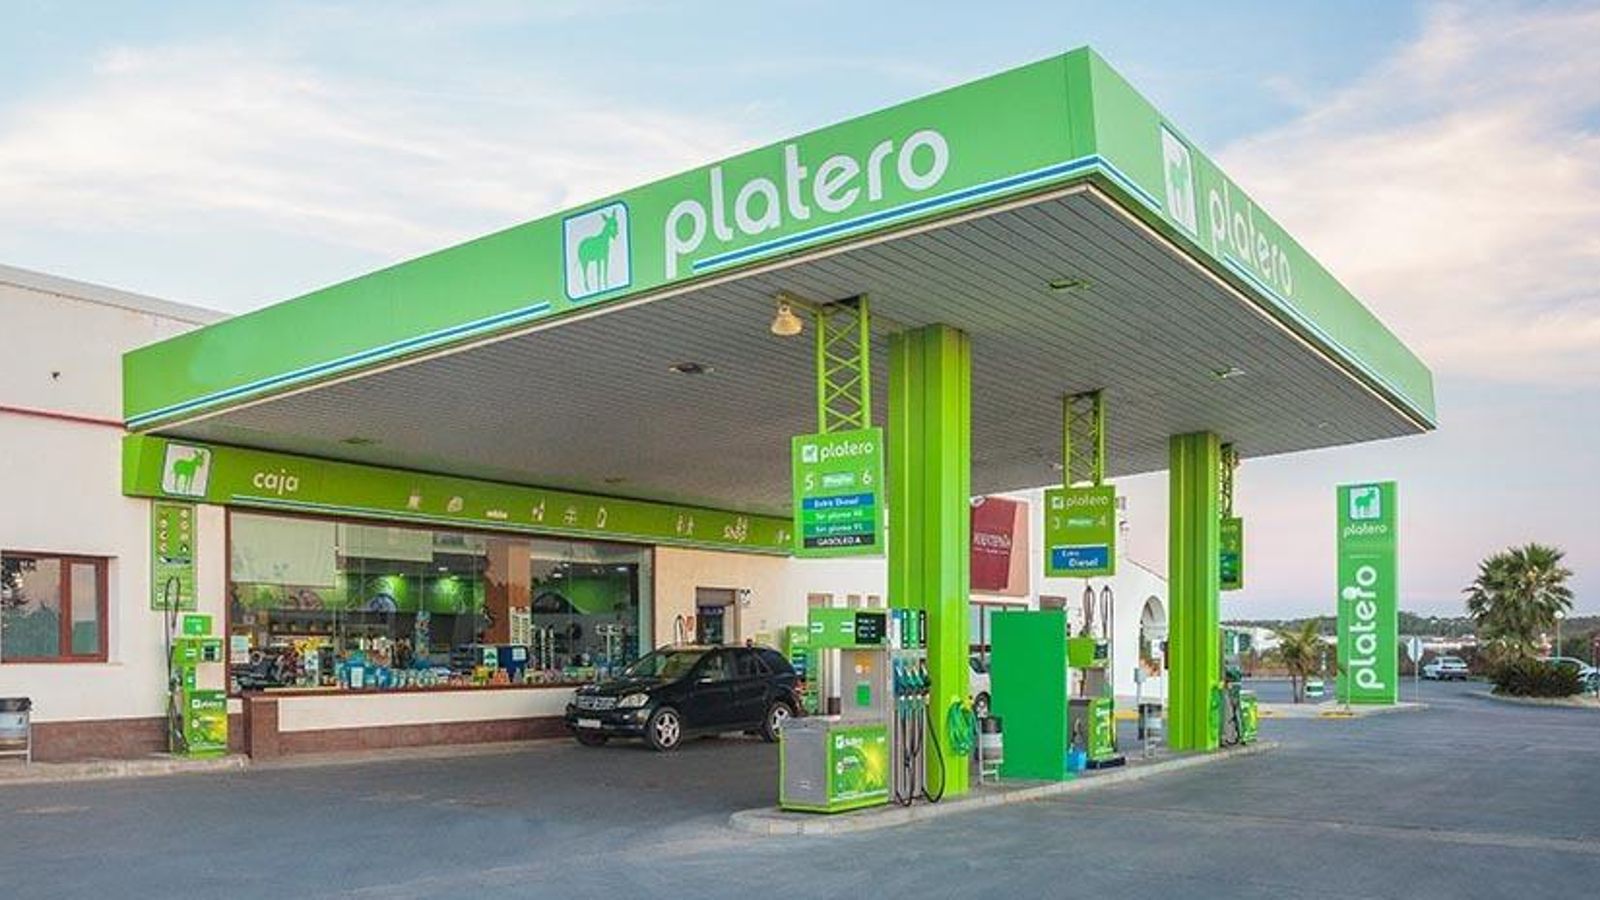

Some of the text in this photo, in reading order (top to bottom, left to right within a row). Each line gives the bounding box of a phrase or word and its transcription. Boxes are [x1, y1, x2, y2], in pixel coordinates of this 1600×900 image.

[665, 130, 949, 279] platero
[1209, 178, 1293, 296] platero
[820, 440, 874, 462] platero
[253, 468, 299, 495] caja
[805, 473, 814, 490] 5
[862, 470, 872, 485] 6
[1343, 523, 1387, 538] platero
[1349, 566, 1385, 689] platero
